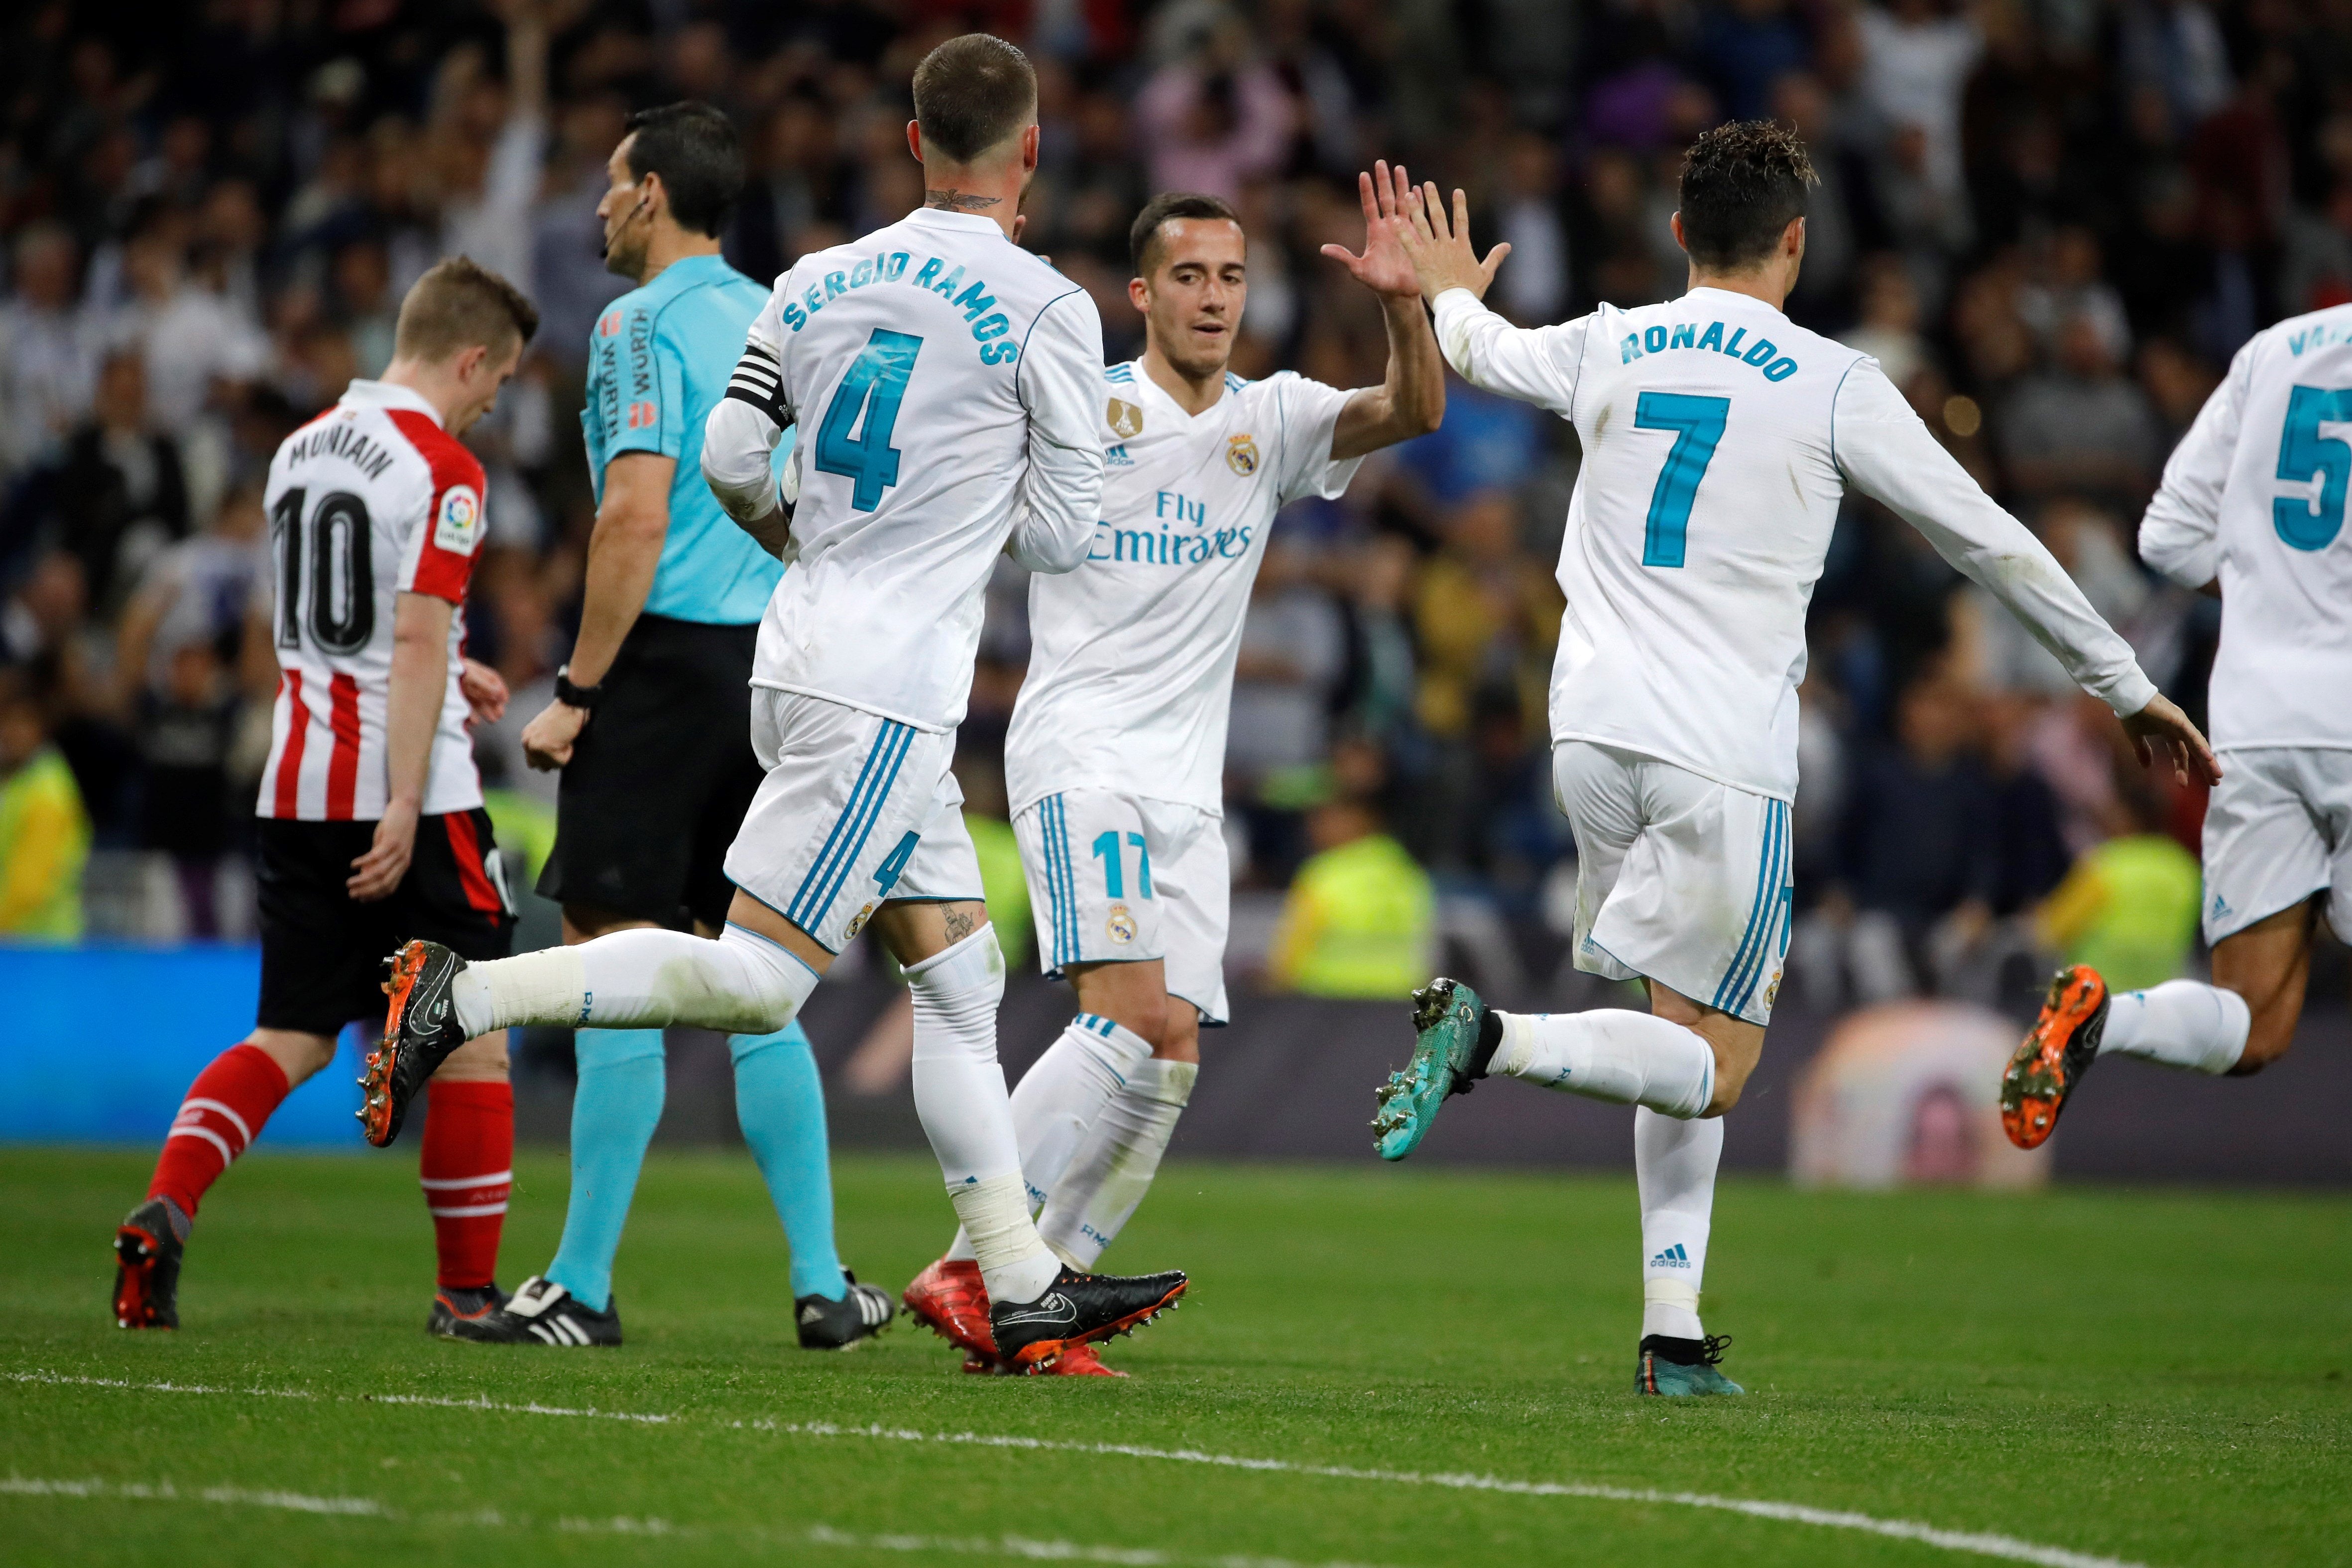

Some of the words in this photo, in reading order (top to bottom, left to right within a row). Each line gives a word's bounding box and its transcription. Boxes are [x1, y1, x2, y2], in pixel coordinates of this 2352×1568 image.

[782, 252, 910, 332] SERGIO
[912, 256, 1018, 366] RAMOS
[1620, 321, 1798, 382] RONALDO
[288, 425, 393, 482] MUNIAIN
[814, 327, 924, 513] 4
[1634, 391, 1732, 568] 7
[2273, 384, 2352, 552] 5
[1086, 521, 1253, 565] Emirates
[1156, 491, 1205, 527] Fly
[272, 486, 375, 657] 10
[872, 830, 921, 898] 4
[1650, 1258, 1691, 1269] adidas
